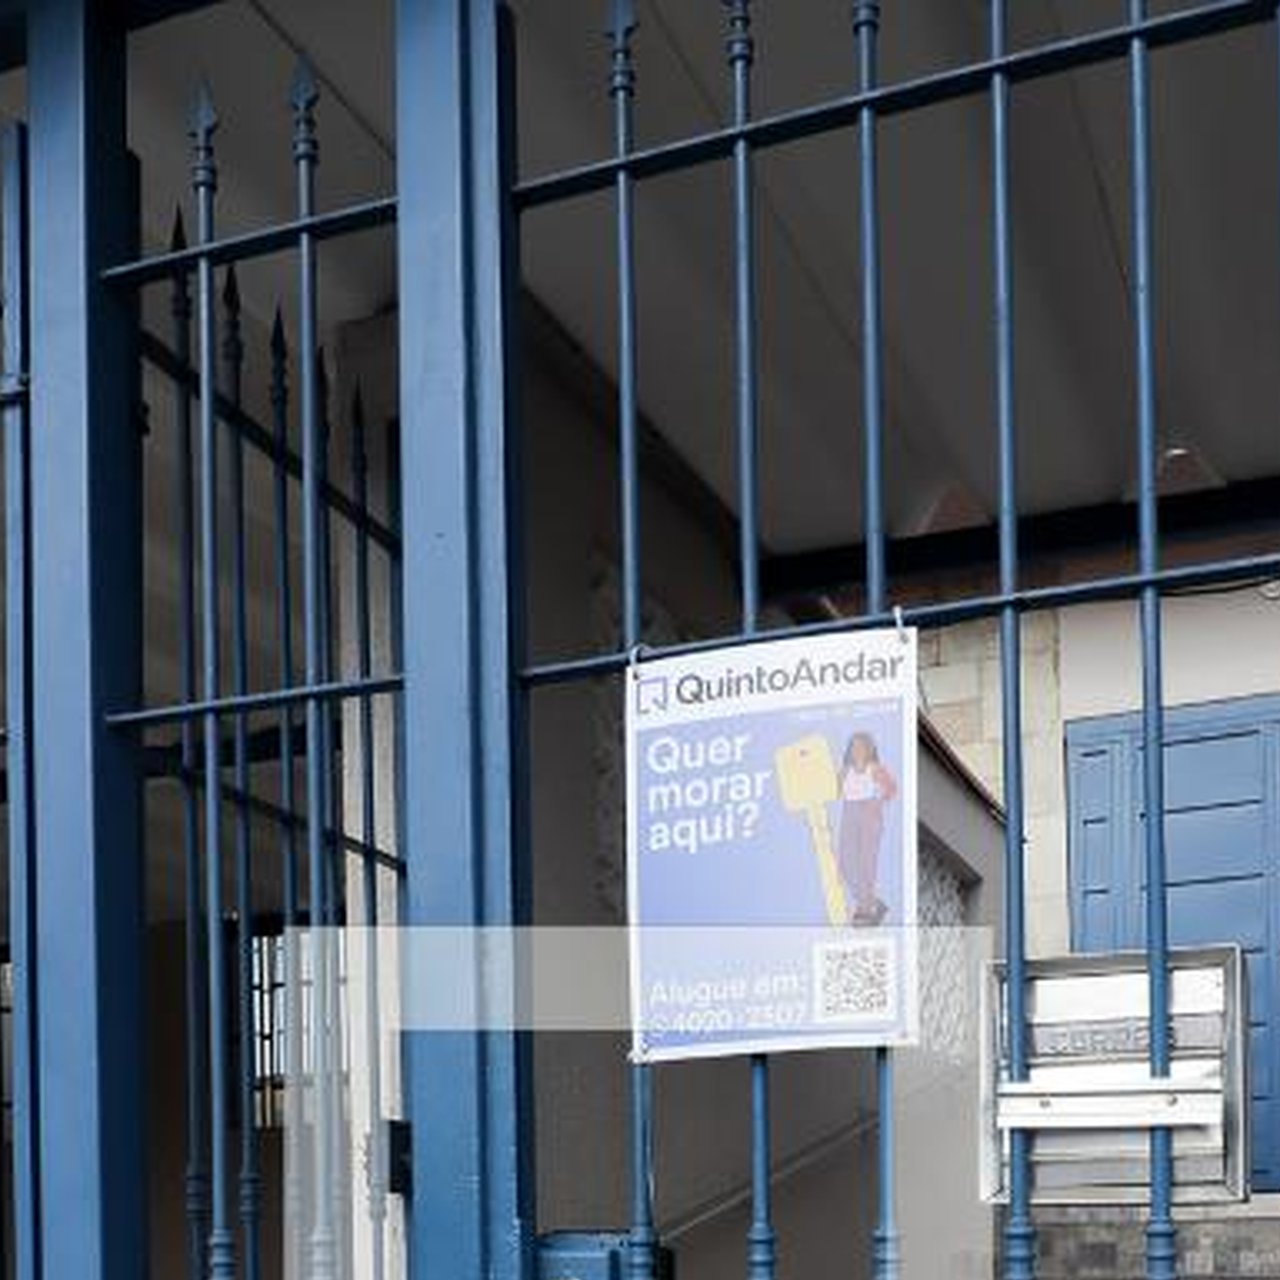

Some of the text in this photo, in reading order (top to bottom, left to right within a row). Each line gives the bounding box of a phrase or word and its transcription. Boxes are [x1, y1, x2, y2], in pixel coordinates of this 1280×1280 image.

[675, 652, 905, 704] QuintoAndar
[647, 733, 752, 774] Quer
[647, 770, 773, 815] morar
[649, 801, 761, 855] aqui?
